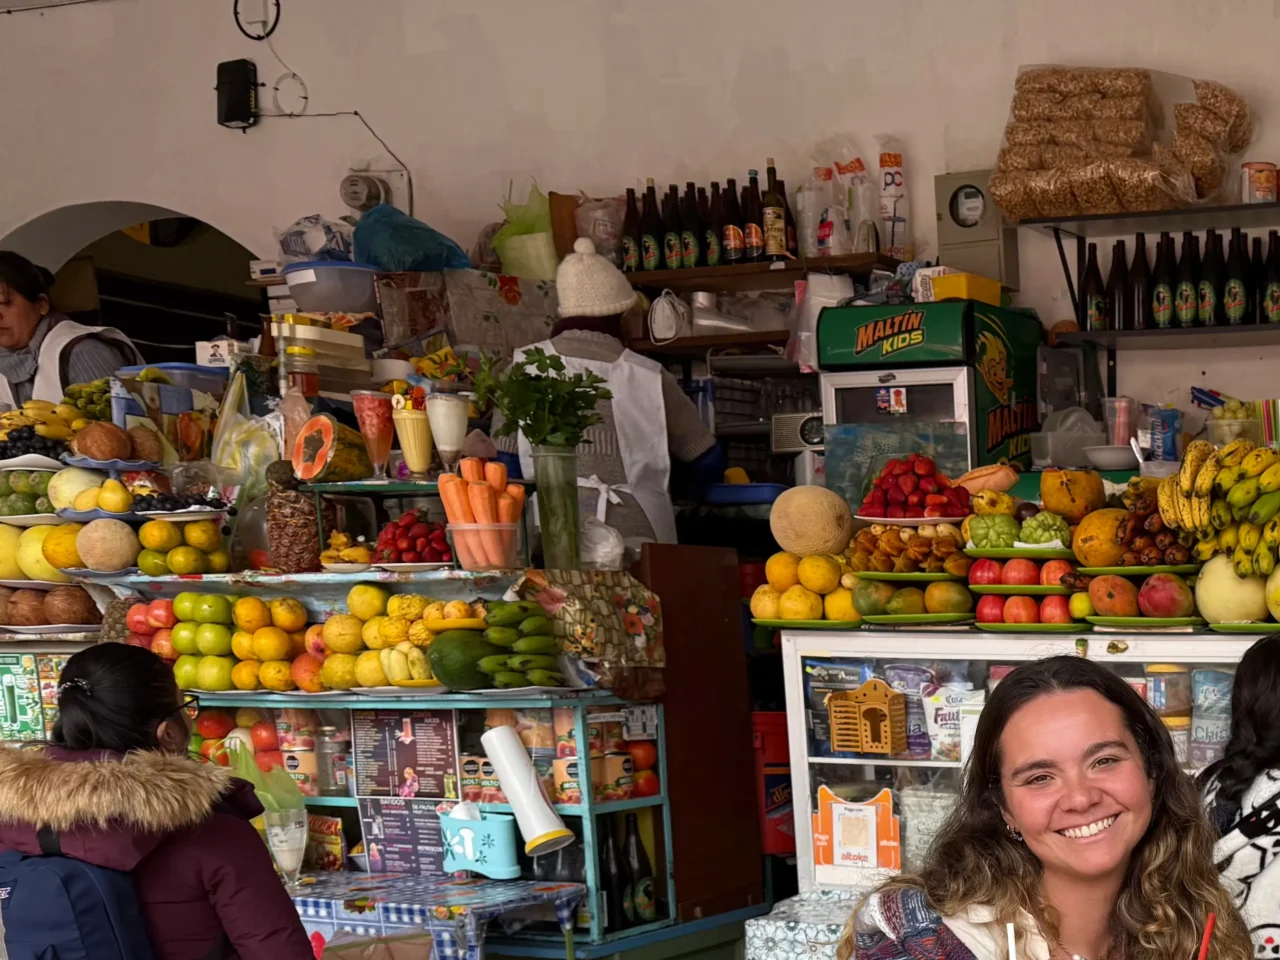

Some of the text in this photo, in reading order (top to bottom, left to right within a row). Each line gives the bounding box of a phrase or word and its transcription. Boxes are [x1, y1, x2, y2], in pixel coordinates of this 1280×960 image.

[855, 309, 924, 355] MALTÍN
[881, 329, 924, 357] KIDS
[1009, 434, 1031, 457] KID
